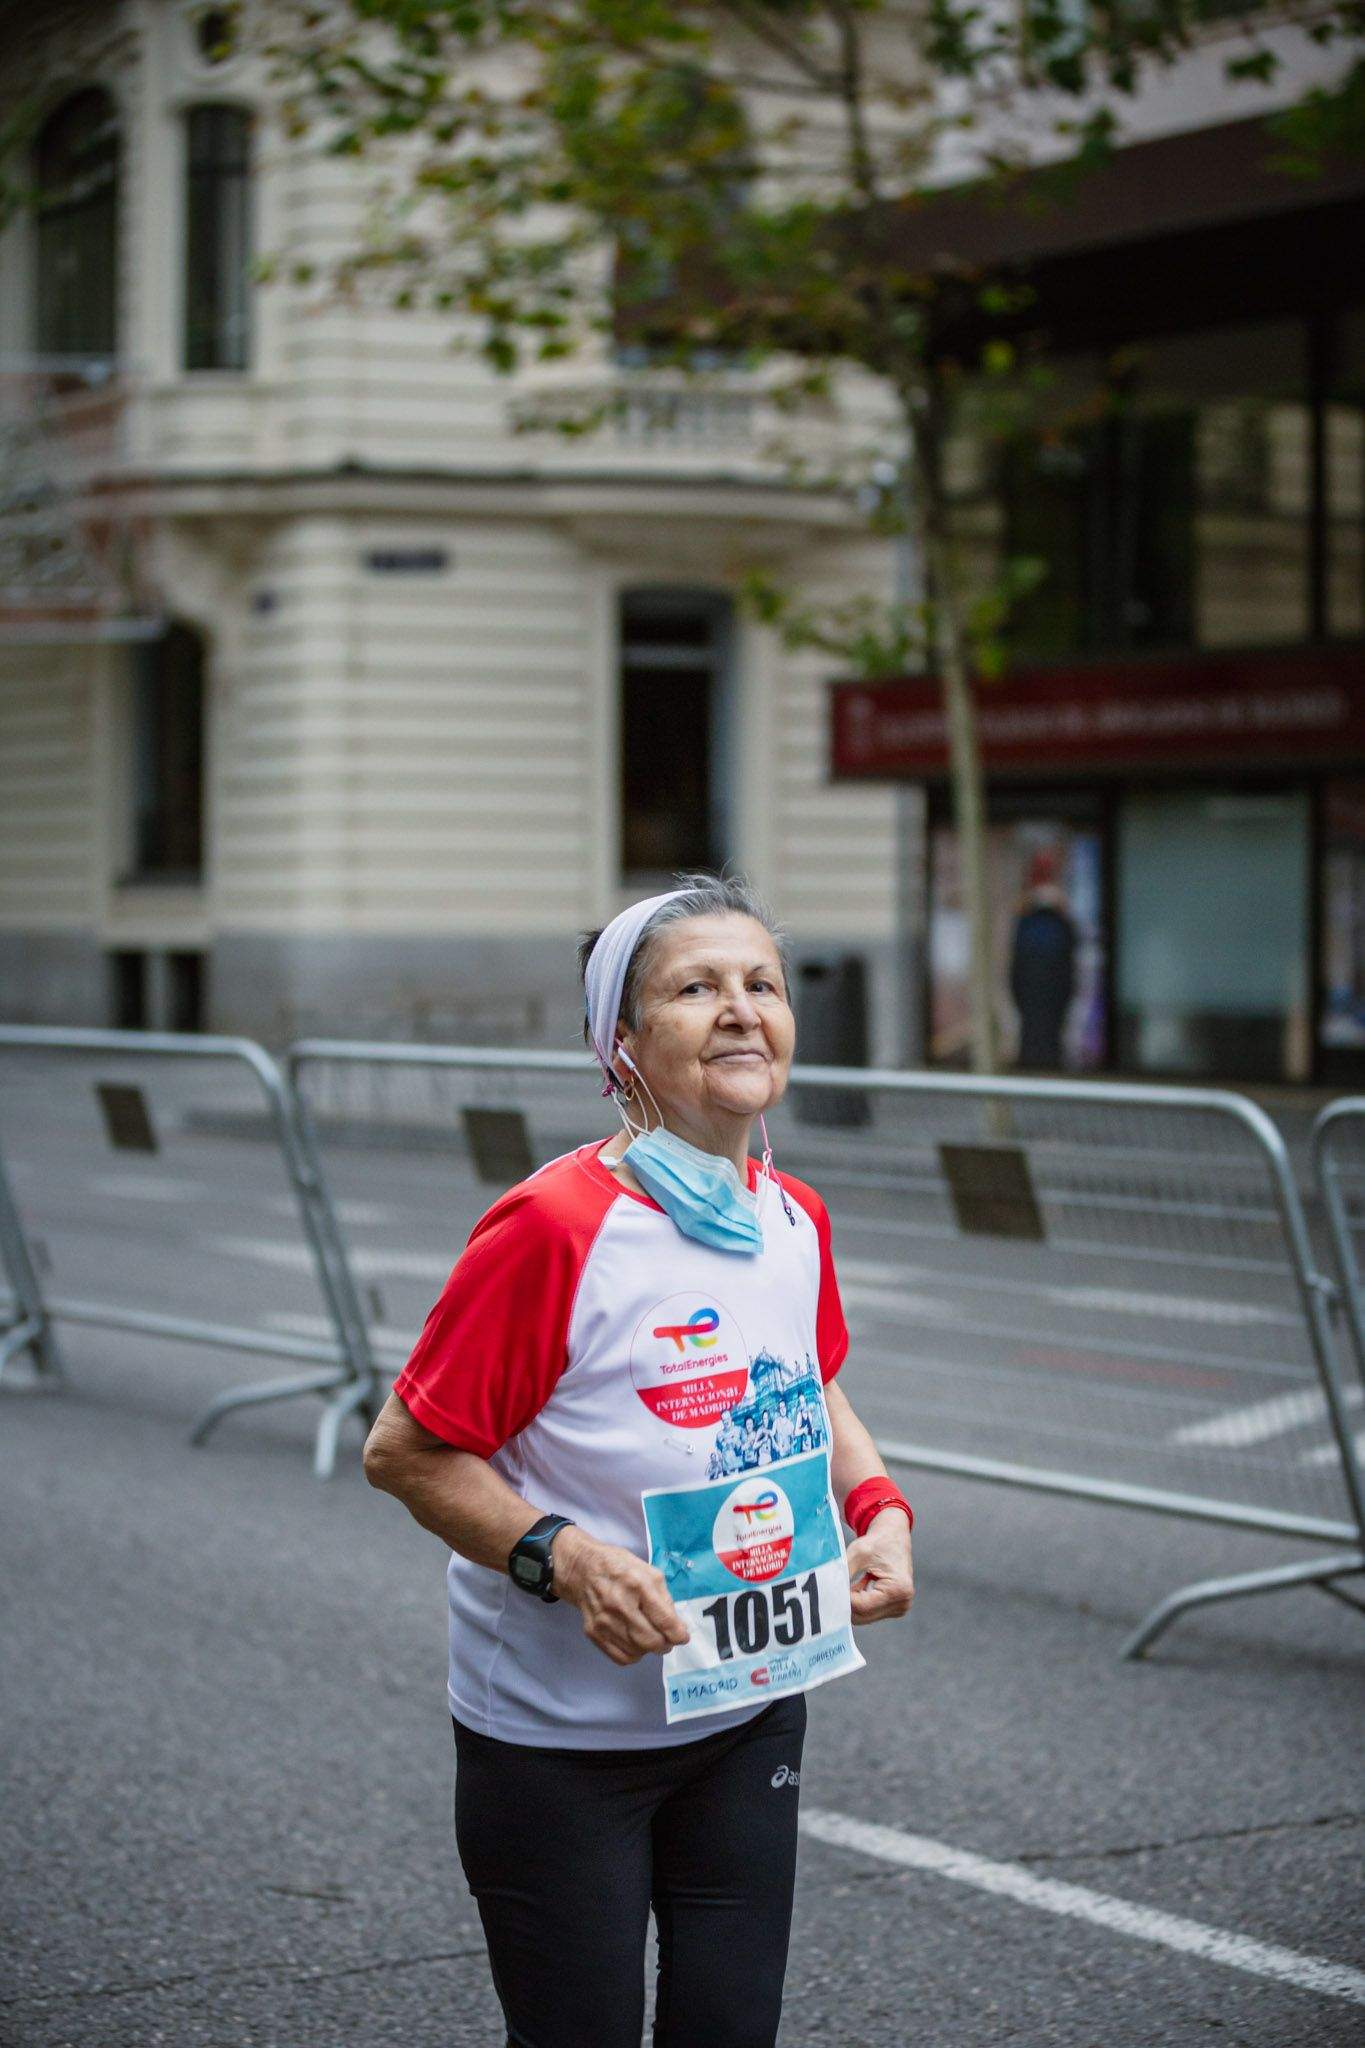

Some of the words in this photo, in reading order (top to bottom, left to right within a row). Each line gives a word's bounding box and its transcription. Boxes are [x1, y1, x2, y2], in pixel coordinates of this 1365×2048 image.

[658, 1354, 728, 1375] TotalEnergies
[682, 1380, 714, 1394] MILLA
[672, 1409, 688, 1421] DE
[690, 1401, 731, 1417] MADRID
[749, 1544, 772, 1557] MILLA
[743, 1567, 755, 1578] DE
[756, 1561, 784, 1575] MADRID
[702, 1572, 822, 1660] 1051
[687, 1677, 738, 1698] MADRID
